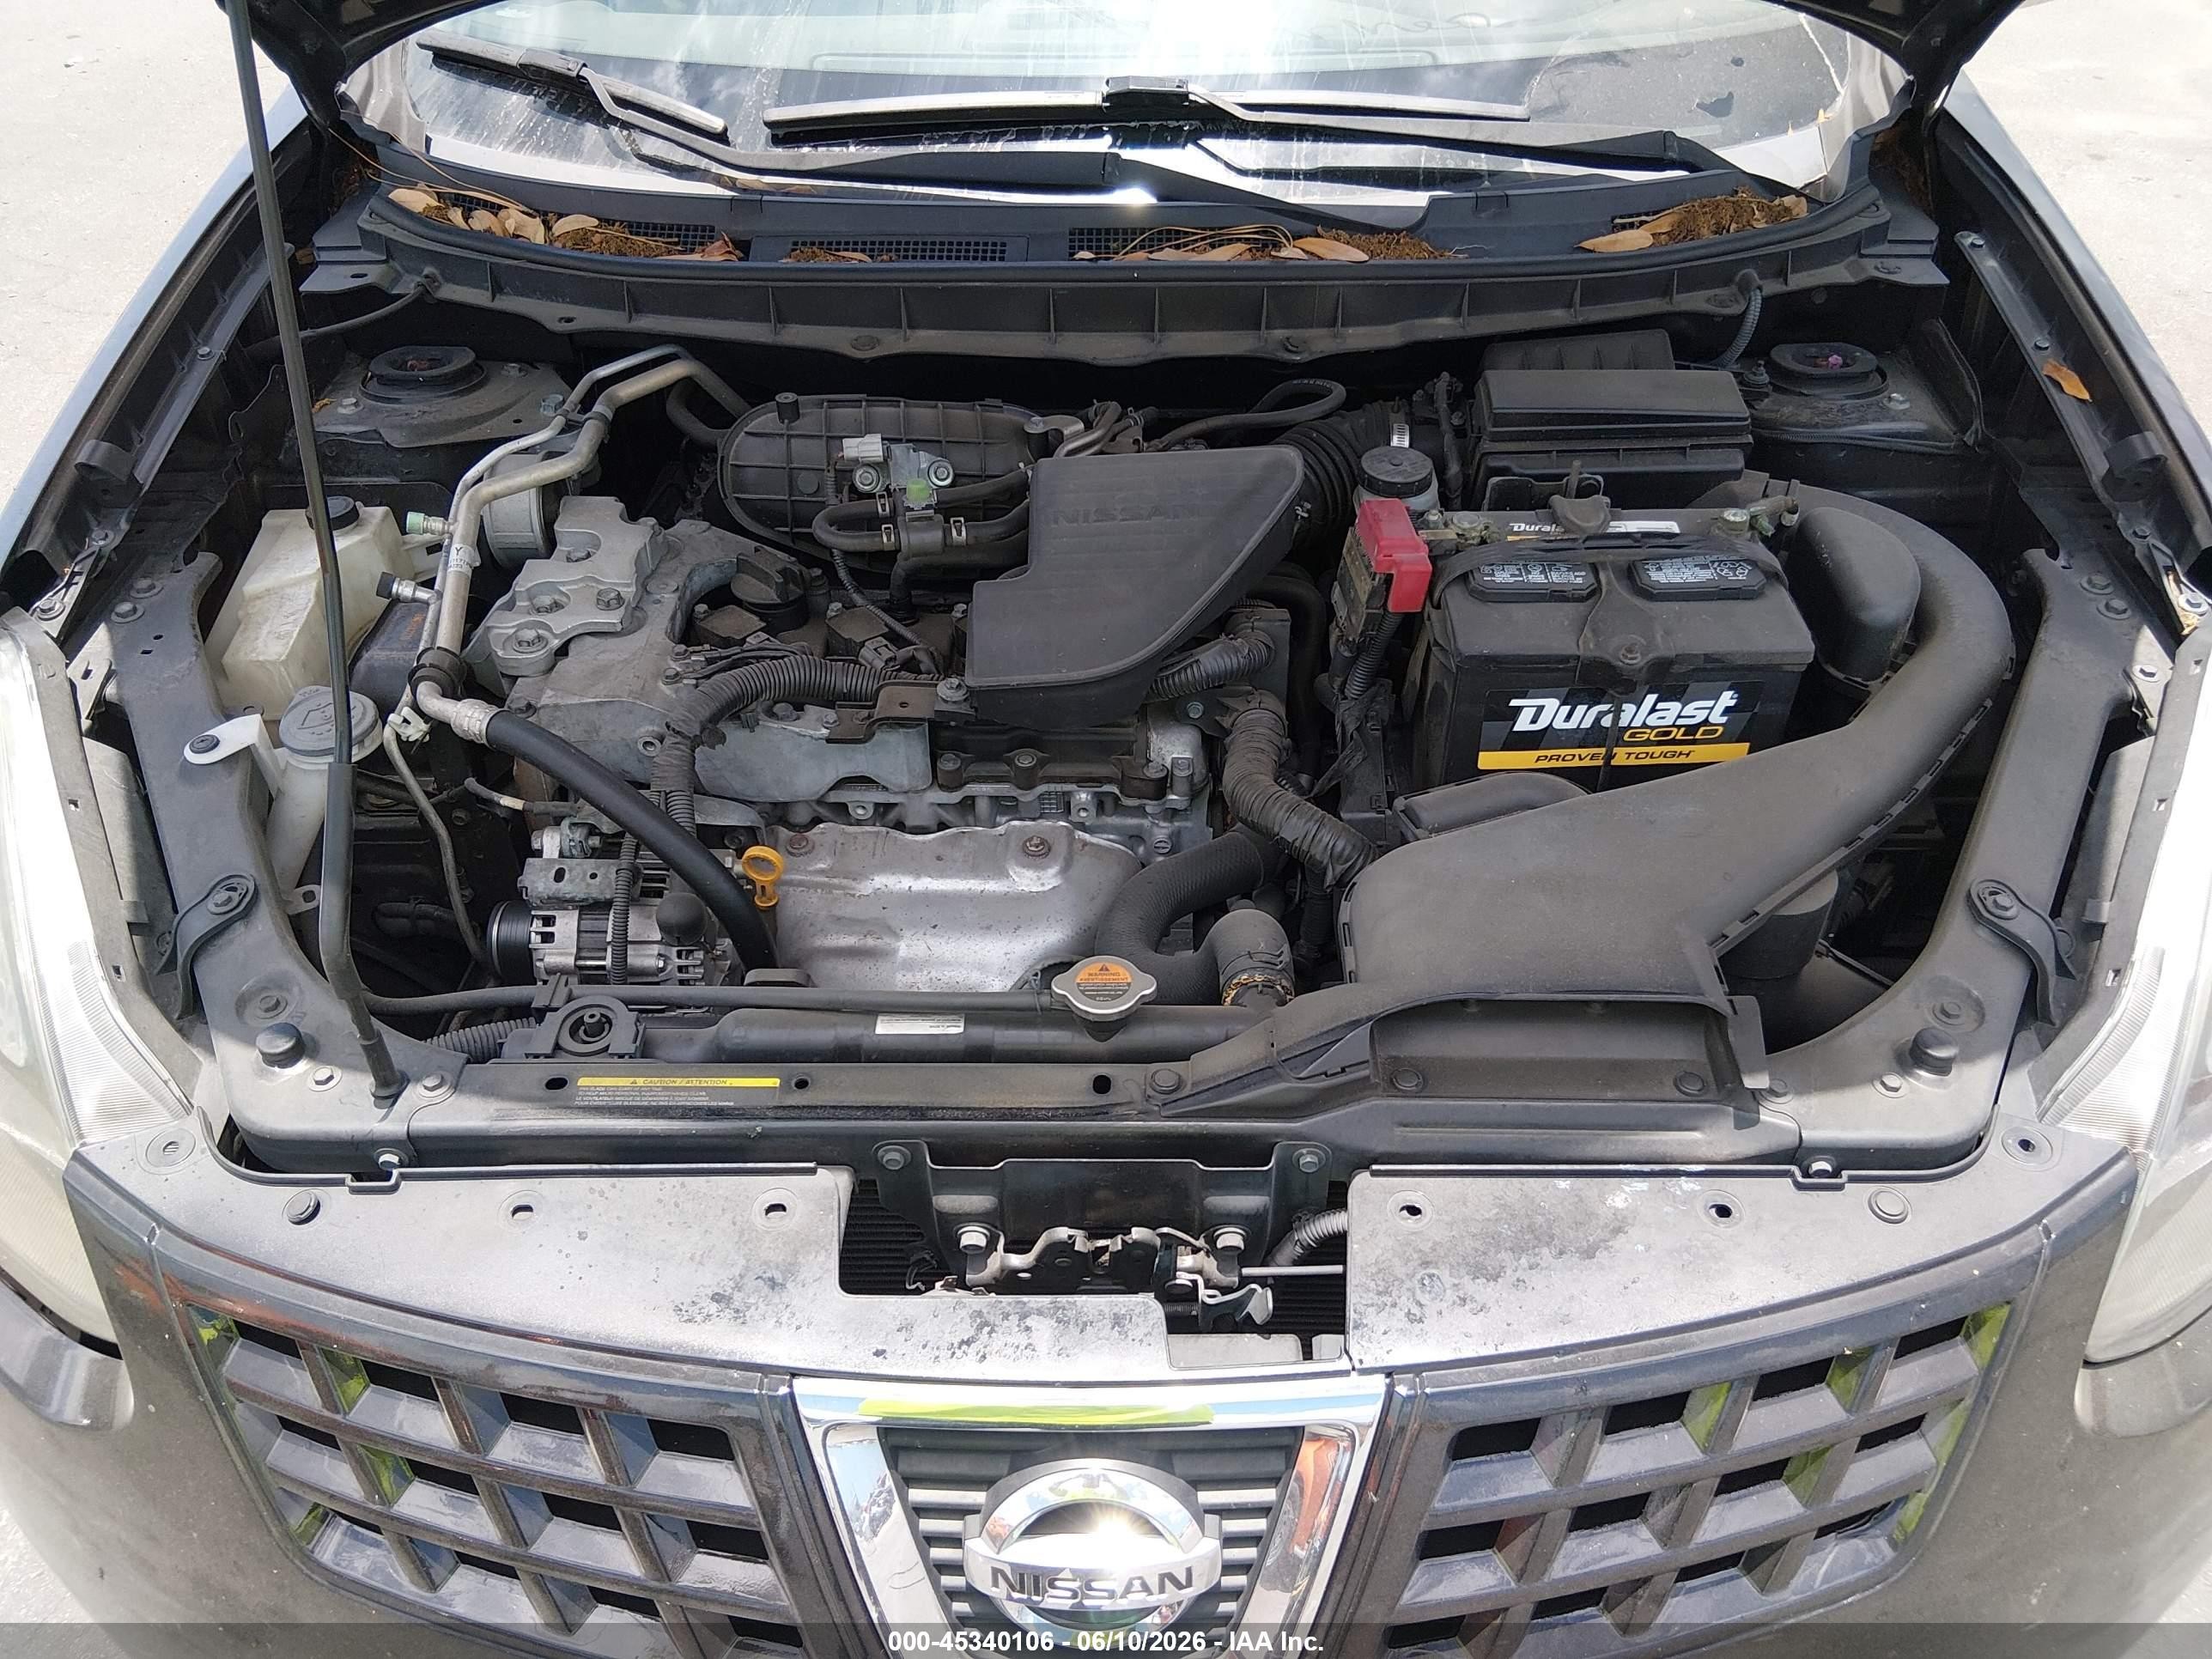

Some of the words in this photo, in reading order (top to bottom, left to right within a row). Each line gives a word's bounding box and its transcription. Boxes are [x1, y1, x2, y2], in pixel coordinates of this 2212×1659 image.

[1508, 690, 1739, 732] Duralast
[1622, 726, 1725, 742] GOLD
[1625, 749, 1695, 761] TOUGH
[990, 1565, 1194, 1601] NISSAN
